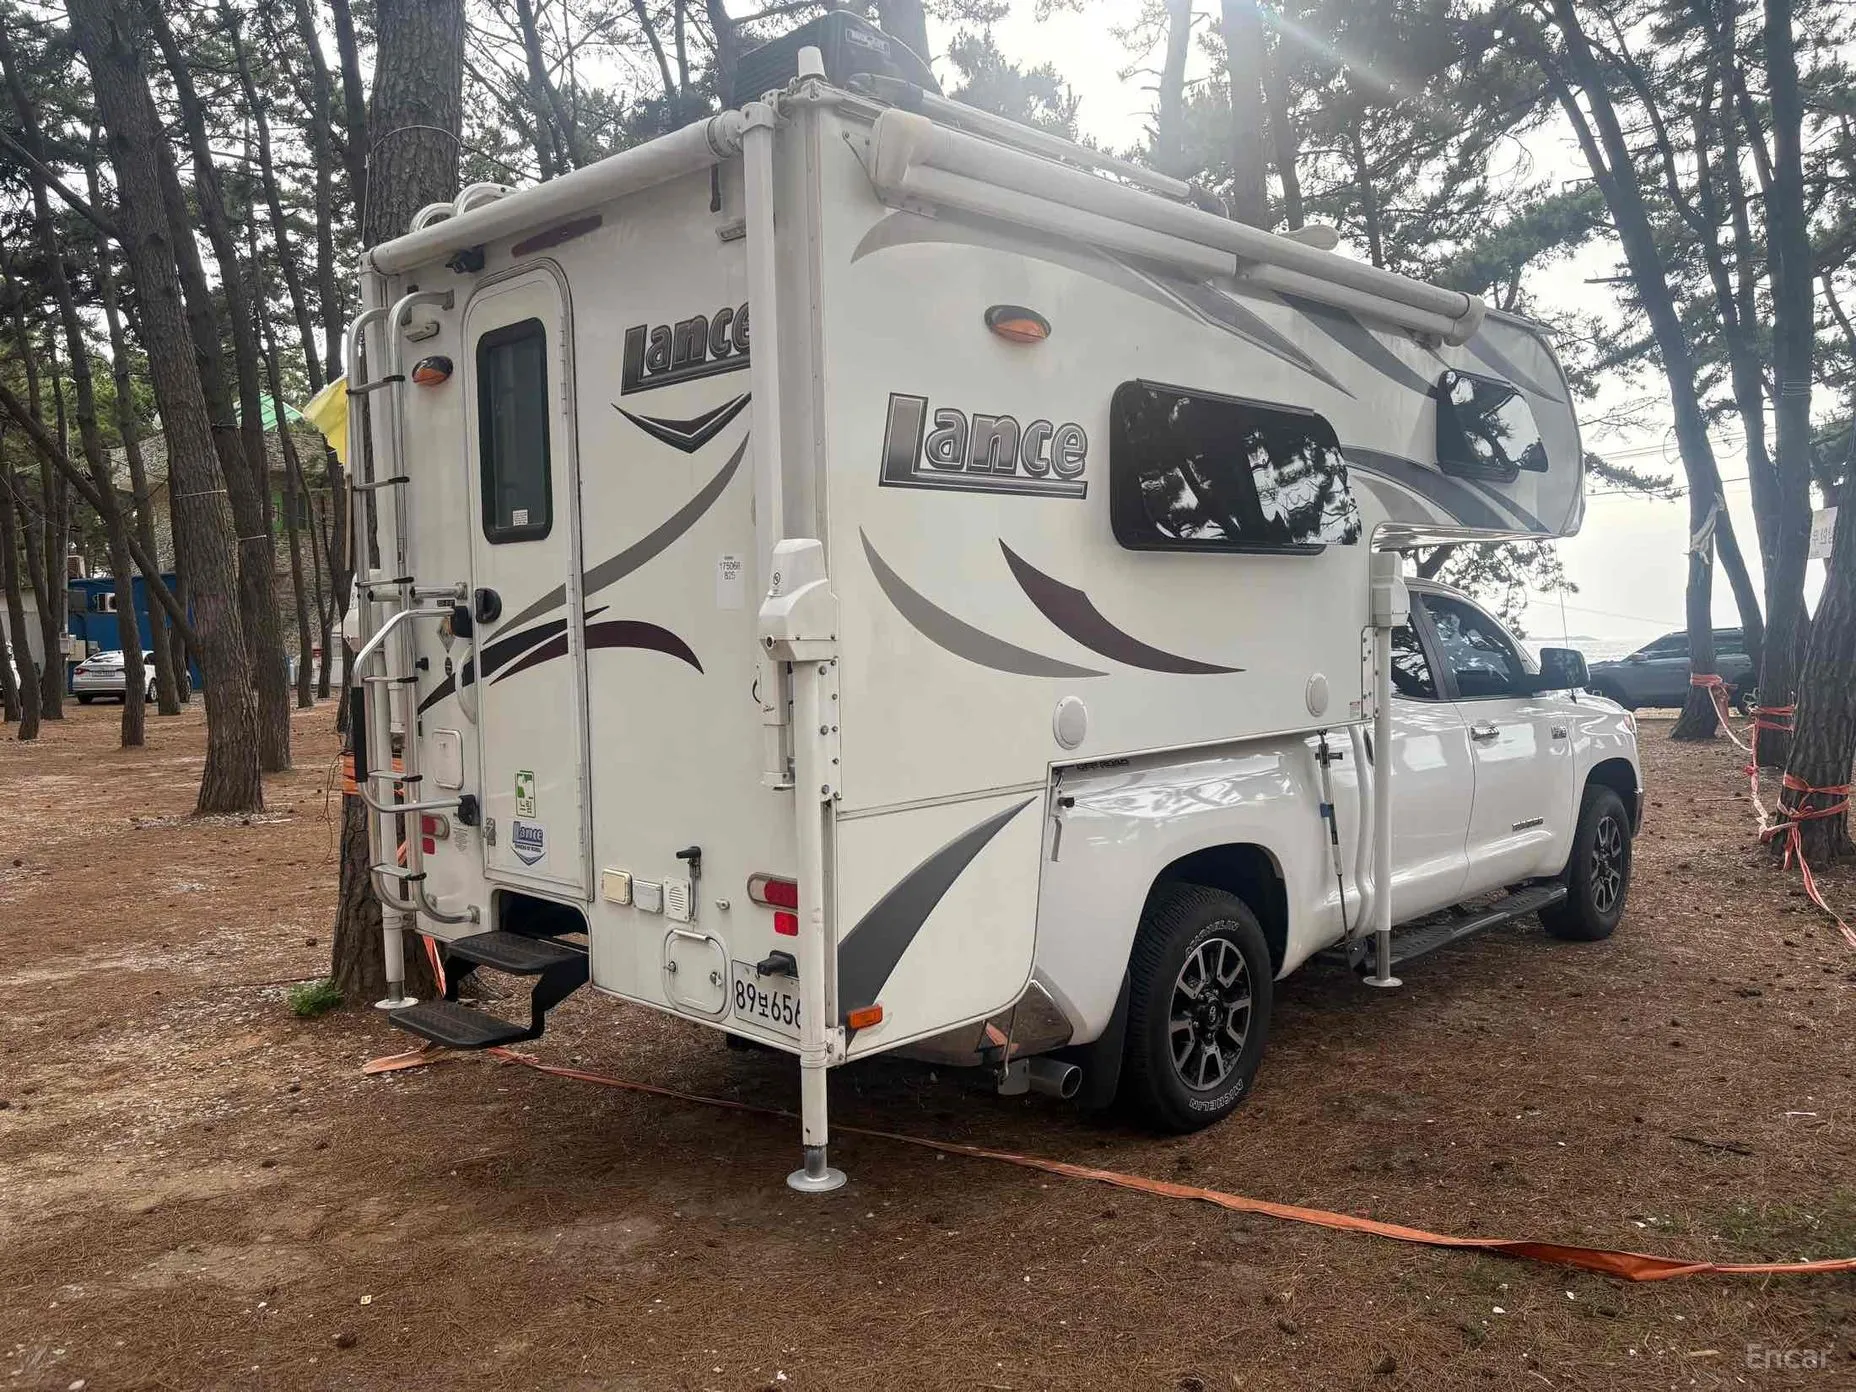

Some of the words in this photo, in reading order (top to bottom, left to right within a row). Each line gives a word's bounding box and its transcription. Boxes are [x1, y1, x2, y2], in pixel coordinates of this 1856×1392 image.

[621, 301, 751, 396] Lance
[879, 392, 1088, 500] Lance
[513, 821, 544, 847] Lance
[1188, 1078, 1244, 1112] MICHELIN
